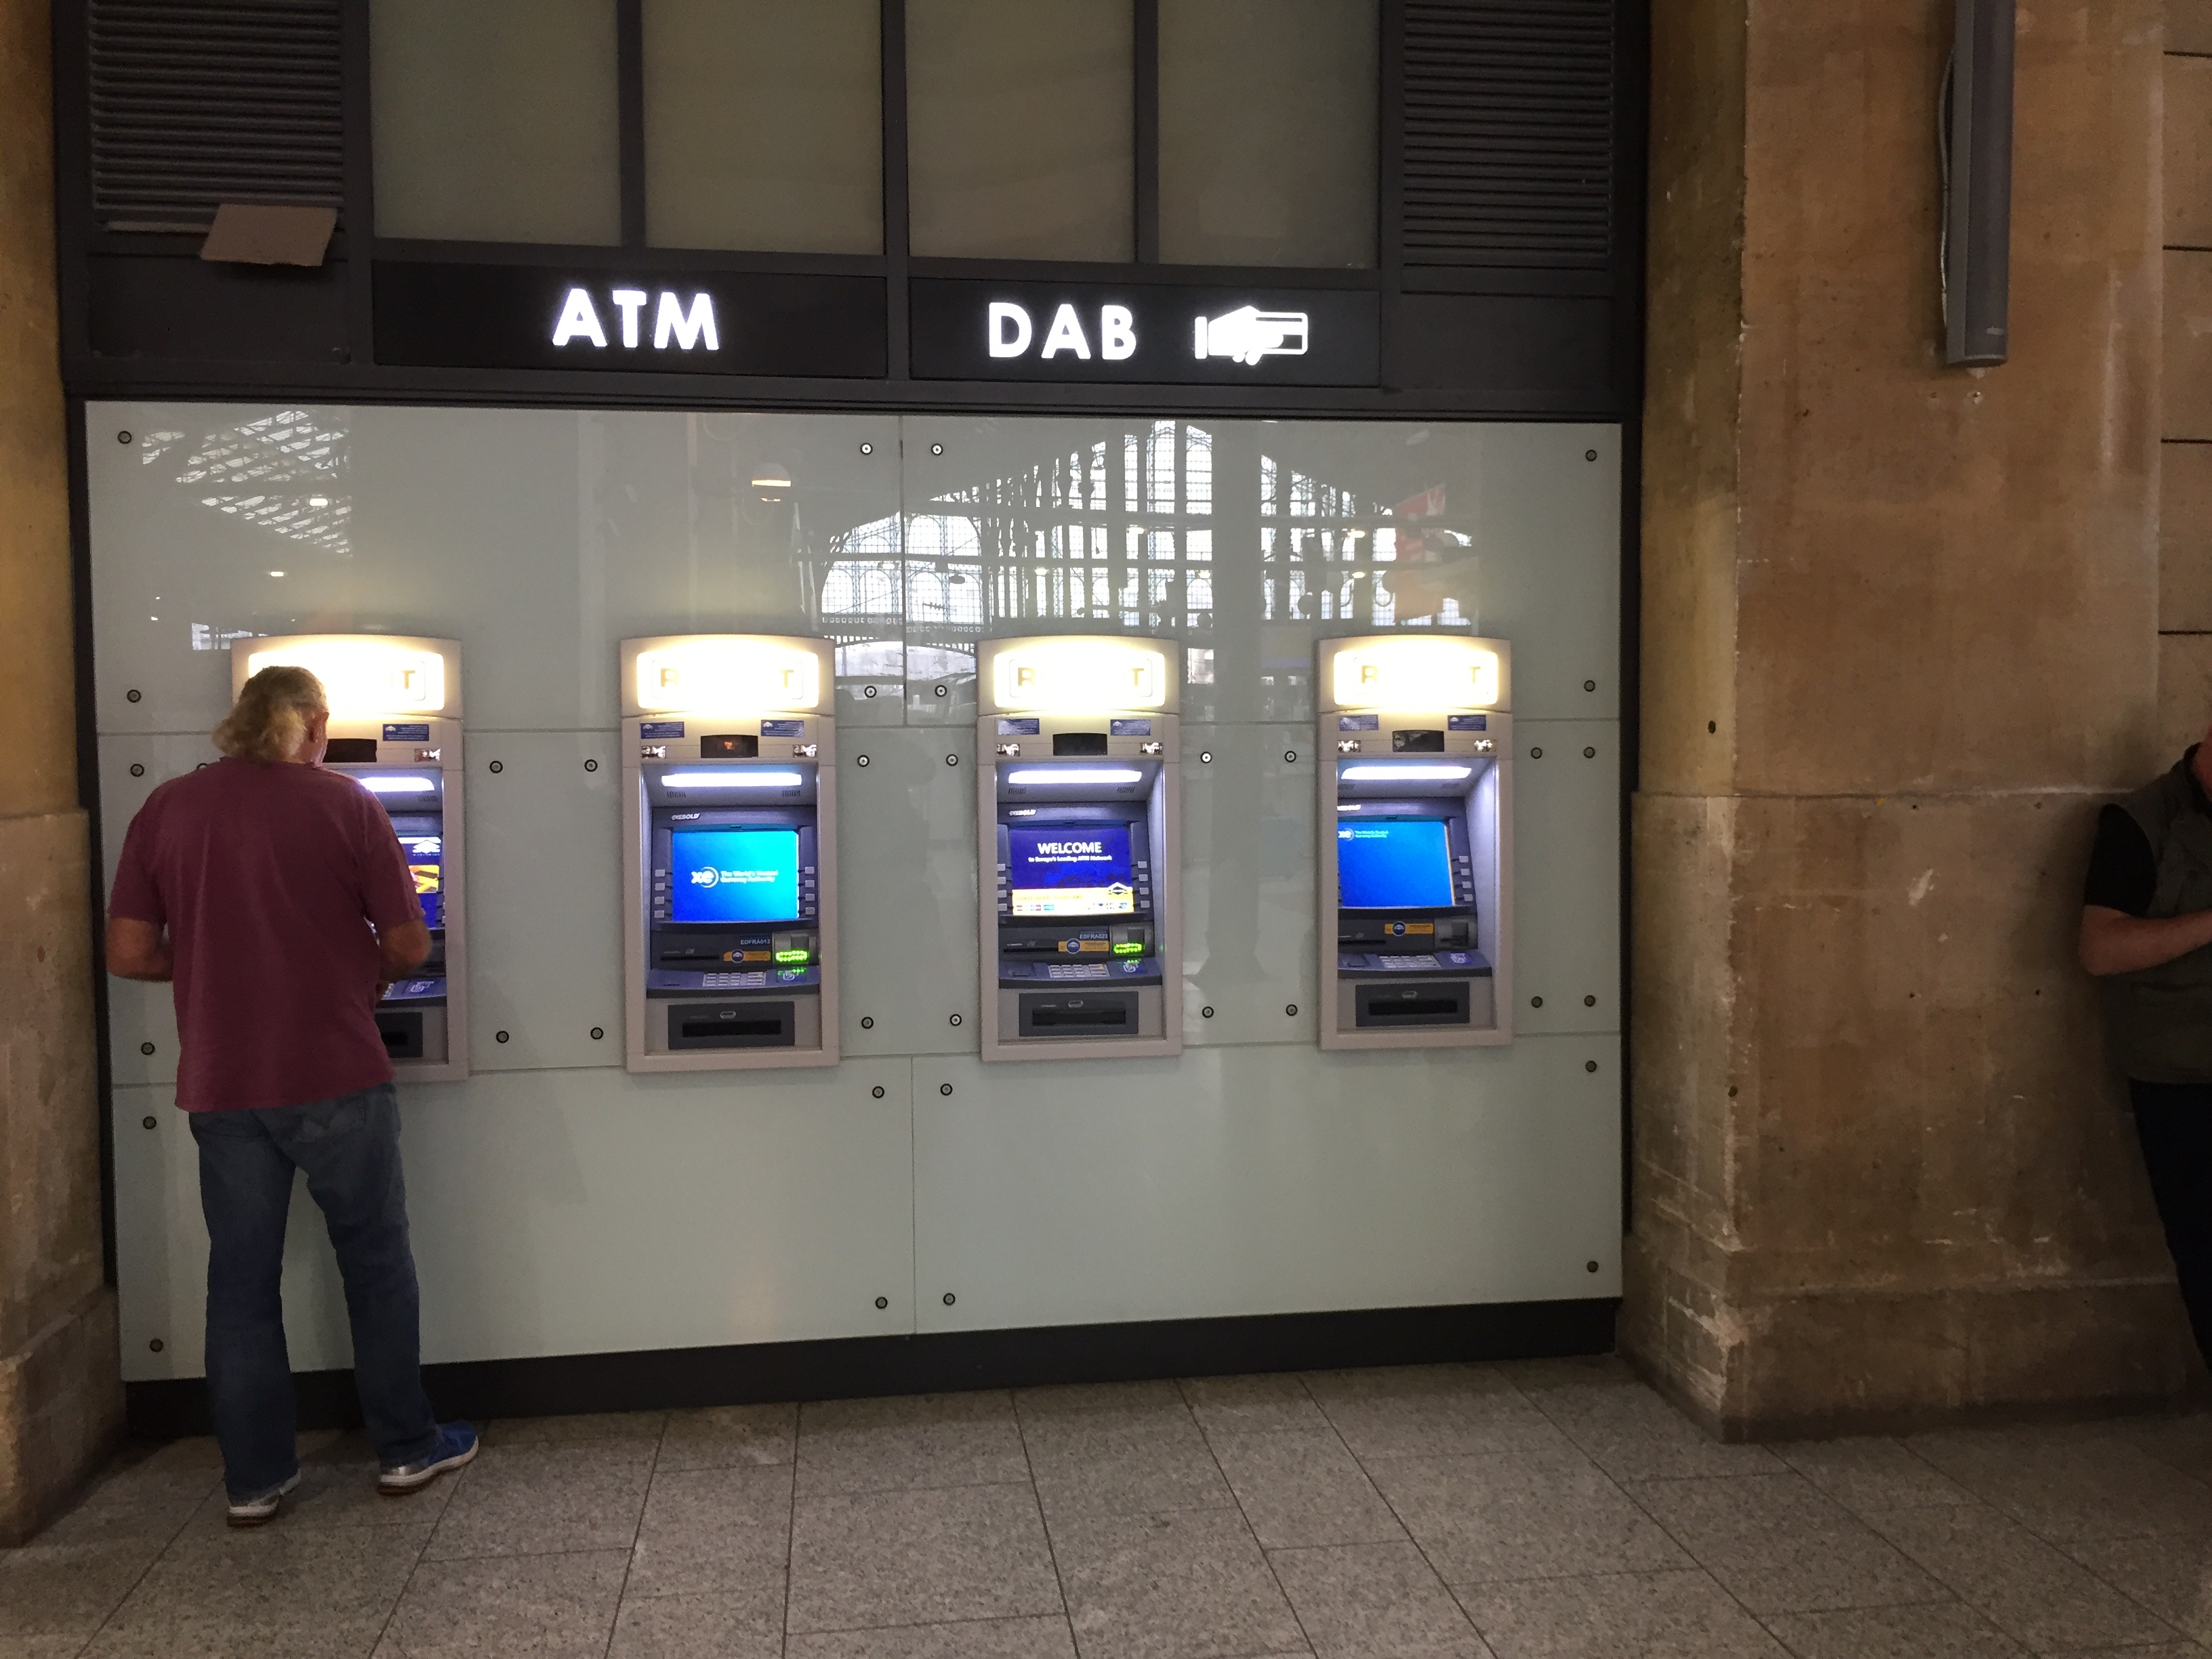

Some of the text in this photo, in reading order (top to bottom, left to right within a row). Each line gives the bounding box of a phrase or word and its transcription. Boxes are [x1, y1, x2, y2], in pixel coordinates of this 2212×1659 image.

[552, 287, 720, 350] ATM
[989, 302, 1137, 360] DAB
[1038, 842, 1102, 854] WELCOME
